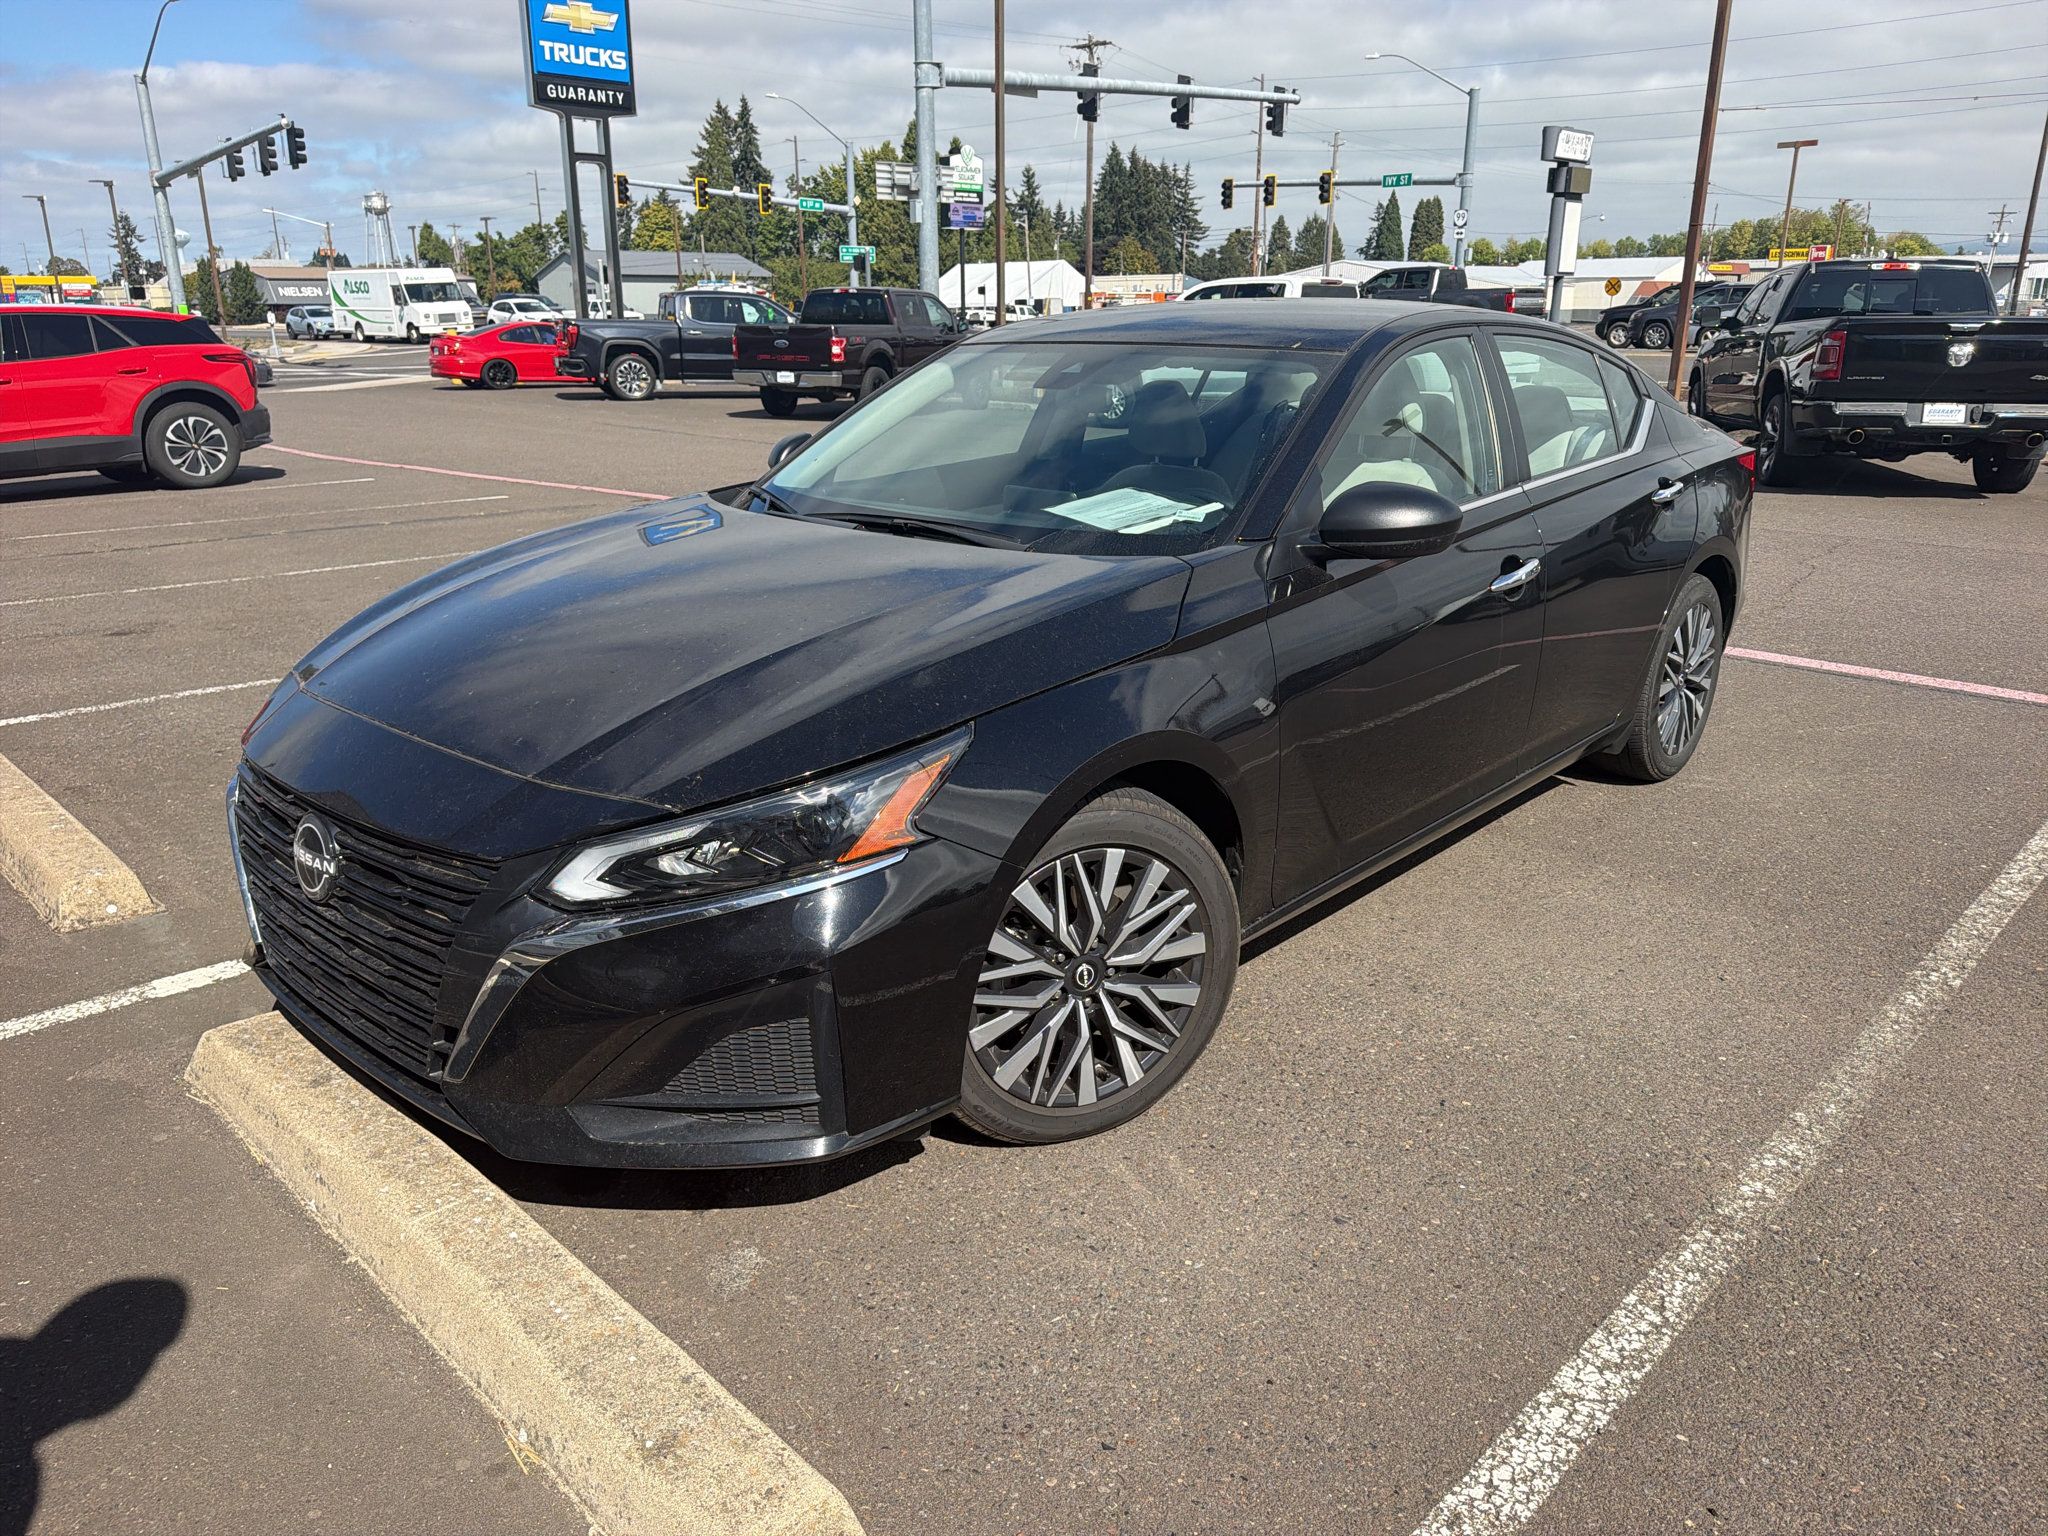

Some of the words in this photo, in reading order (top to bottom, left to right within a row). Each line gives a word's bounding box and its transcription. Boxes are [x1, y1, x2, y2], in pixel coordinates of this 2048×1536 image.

[539, 40, 627, 70] TRUCKS
[547, 84, 624, 104] GUARANTY
[1385, 176, 1397, 186] IVY
[1400, 175, 1409, 185] ST
[1456, 212, 1466, 221] 99
[278, 286, 323, 297] NIELSEN
[343, 279, 370, 294] ALSCO
[295, 842, 334, 874] SSAN
